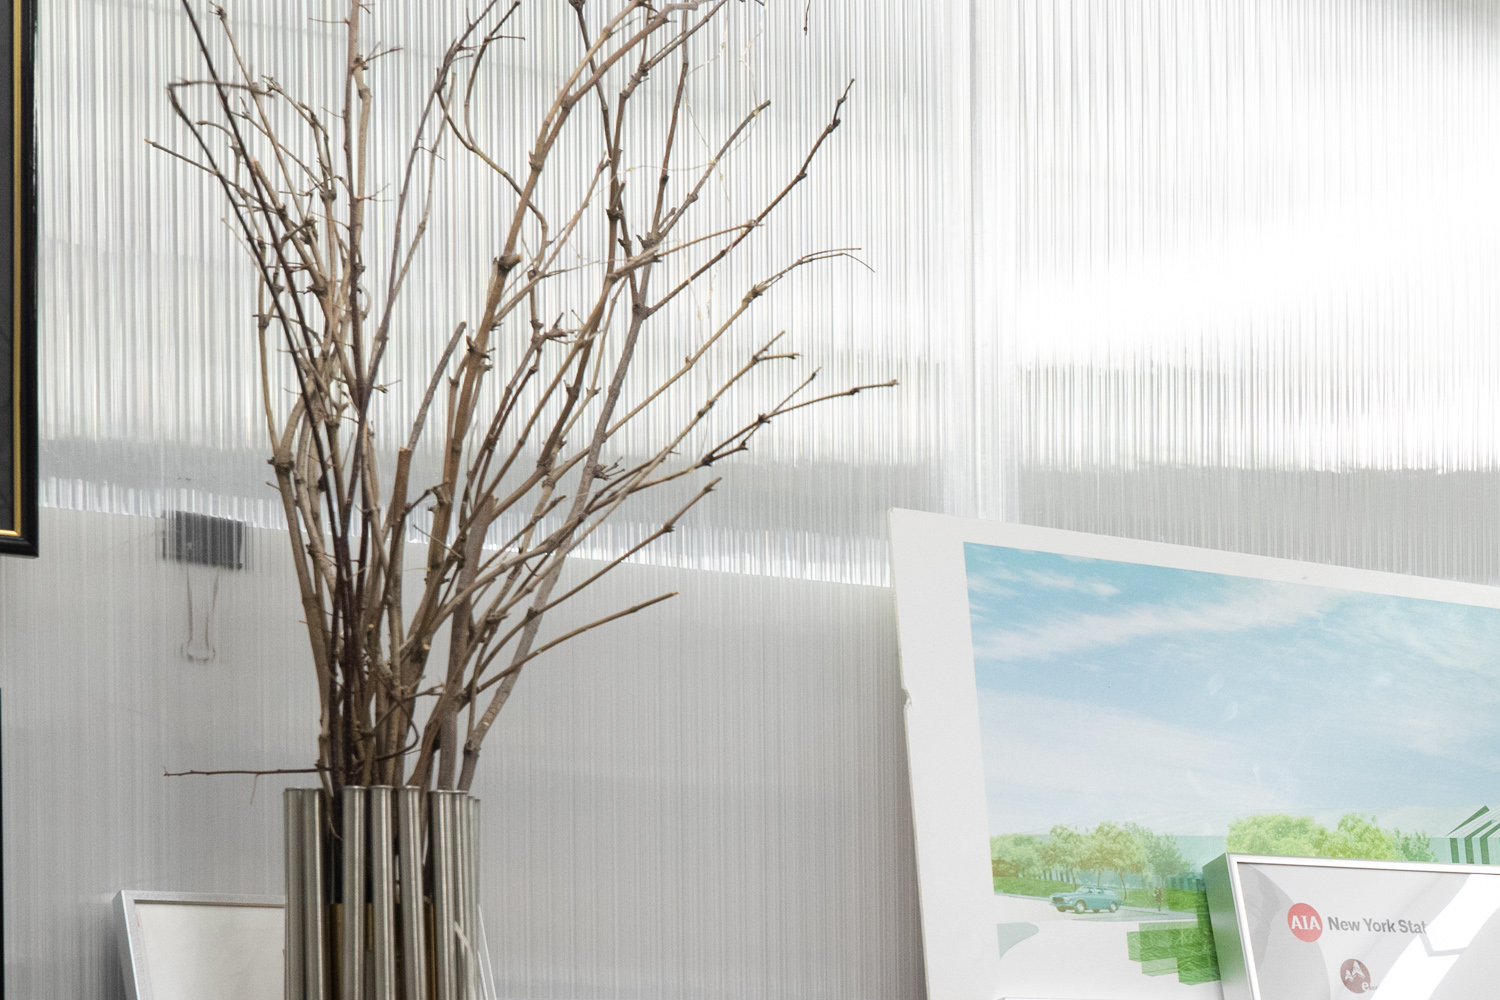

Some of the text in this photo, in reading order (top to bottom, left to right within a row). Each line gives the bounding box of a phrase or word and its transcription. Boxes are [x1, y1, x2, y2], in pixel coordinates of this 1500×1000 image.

[1291, 915, 1321, 930] AIA
[1327, 917, 1360, 931] New
[1362, 918, 1397, 933] York
